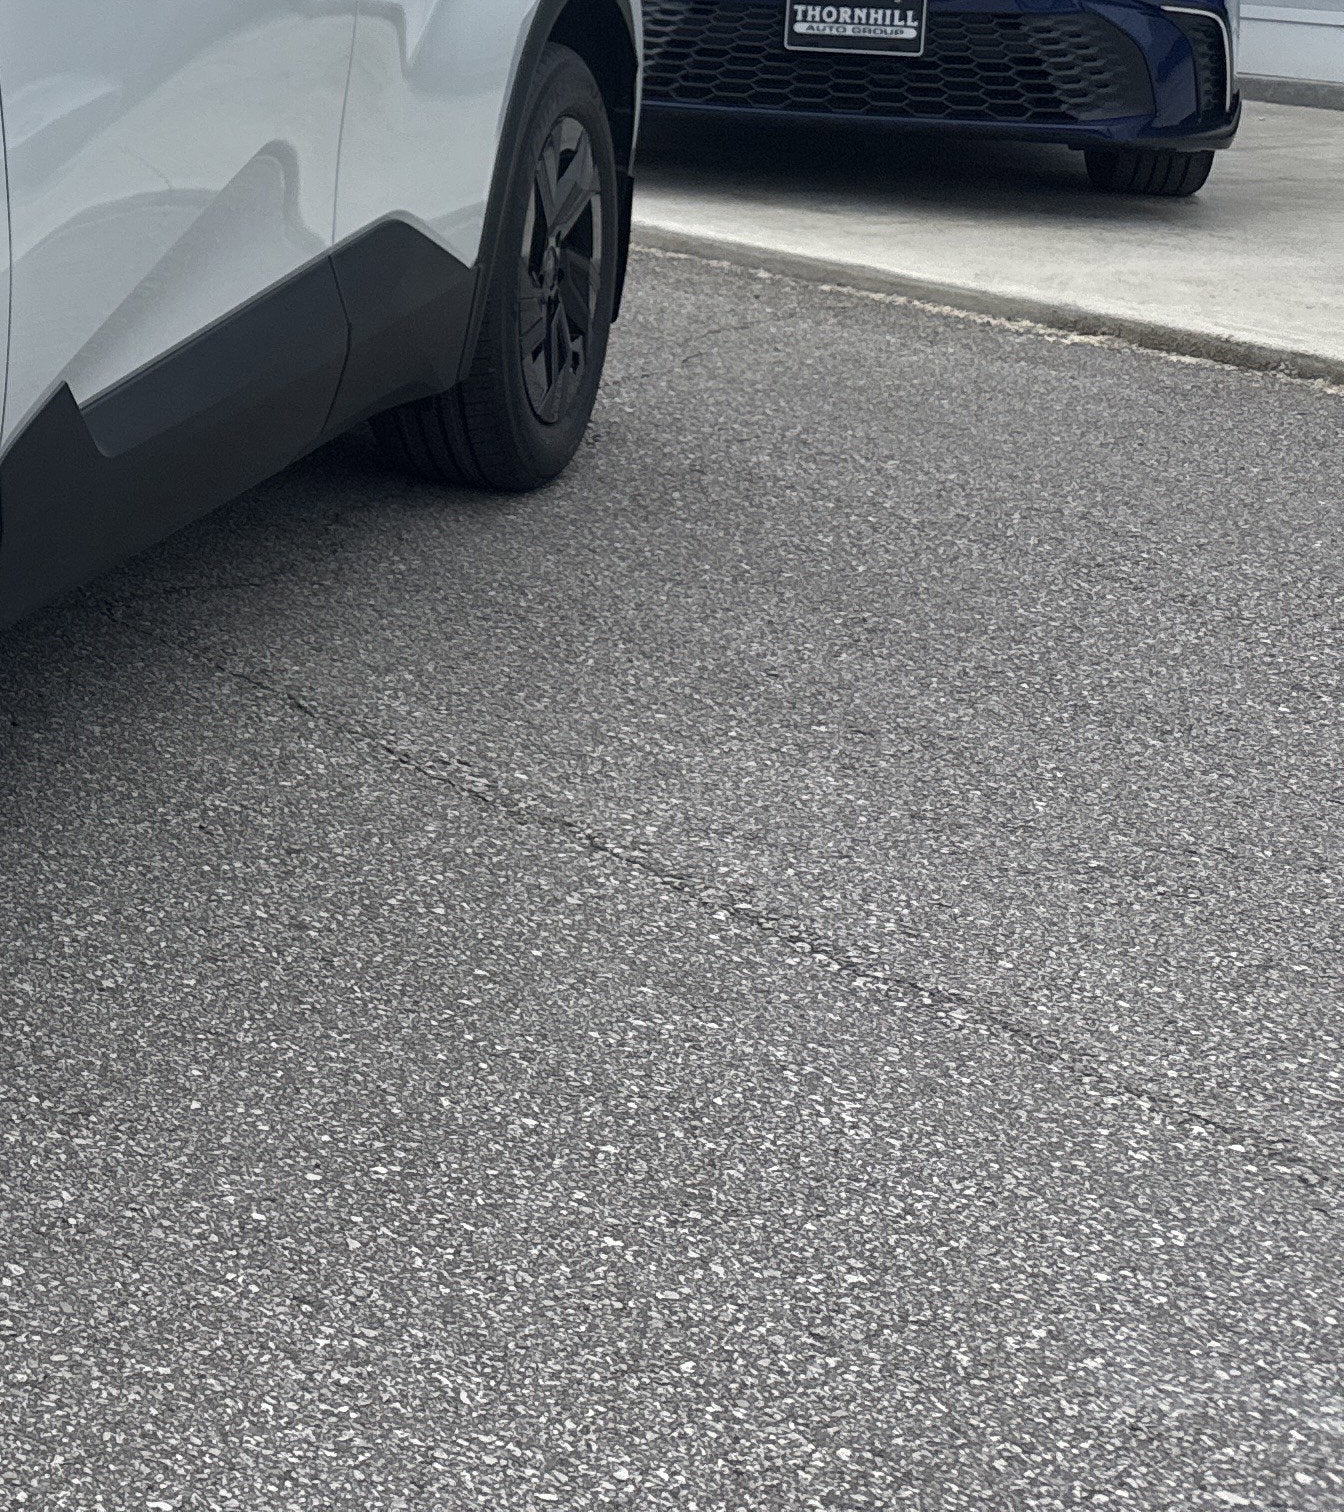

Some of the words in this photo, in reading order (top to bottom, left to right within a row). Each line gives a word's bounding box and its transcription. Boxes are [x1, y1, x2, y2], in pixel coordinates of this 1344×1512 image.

[793, 4, 919, 27] THORNHILL
[806, 24, 847, 34] AUTO
[851, 26, 905, 36] GROUP
